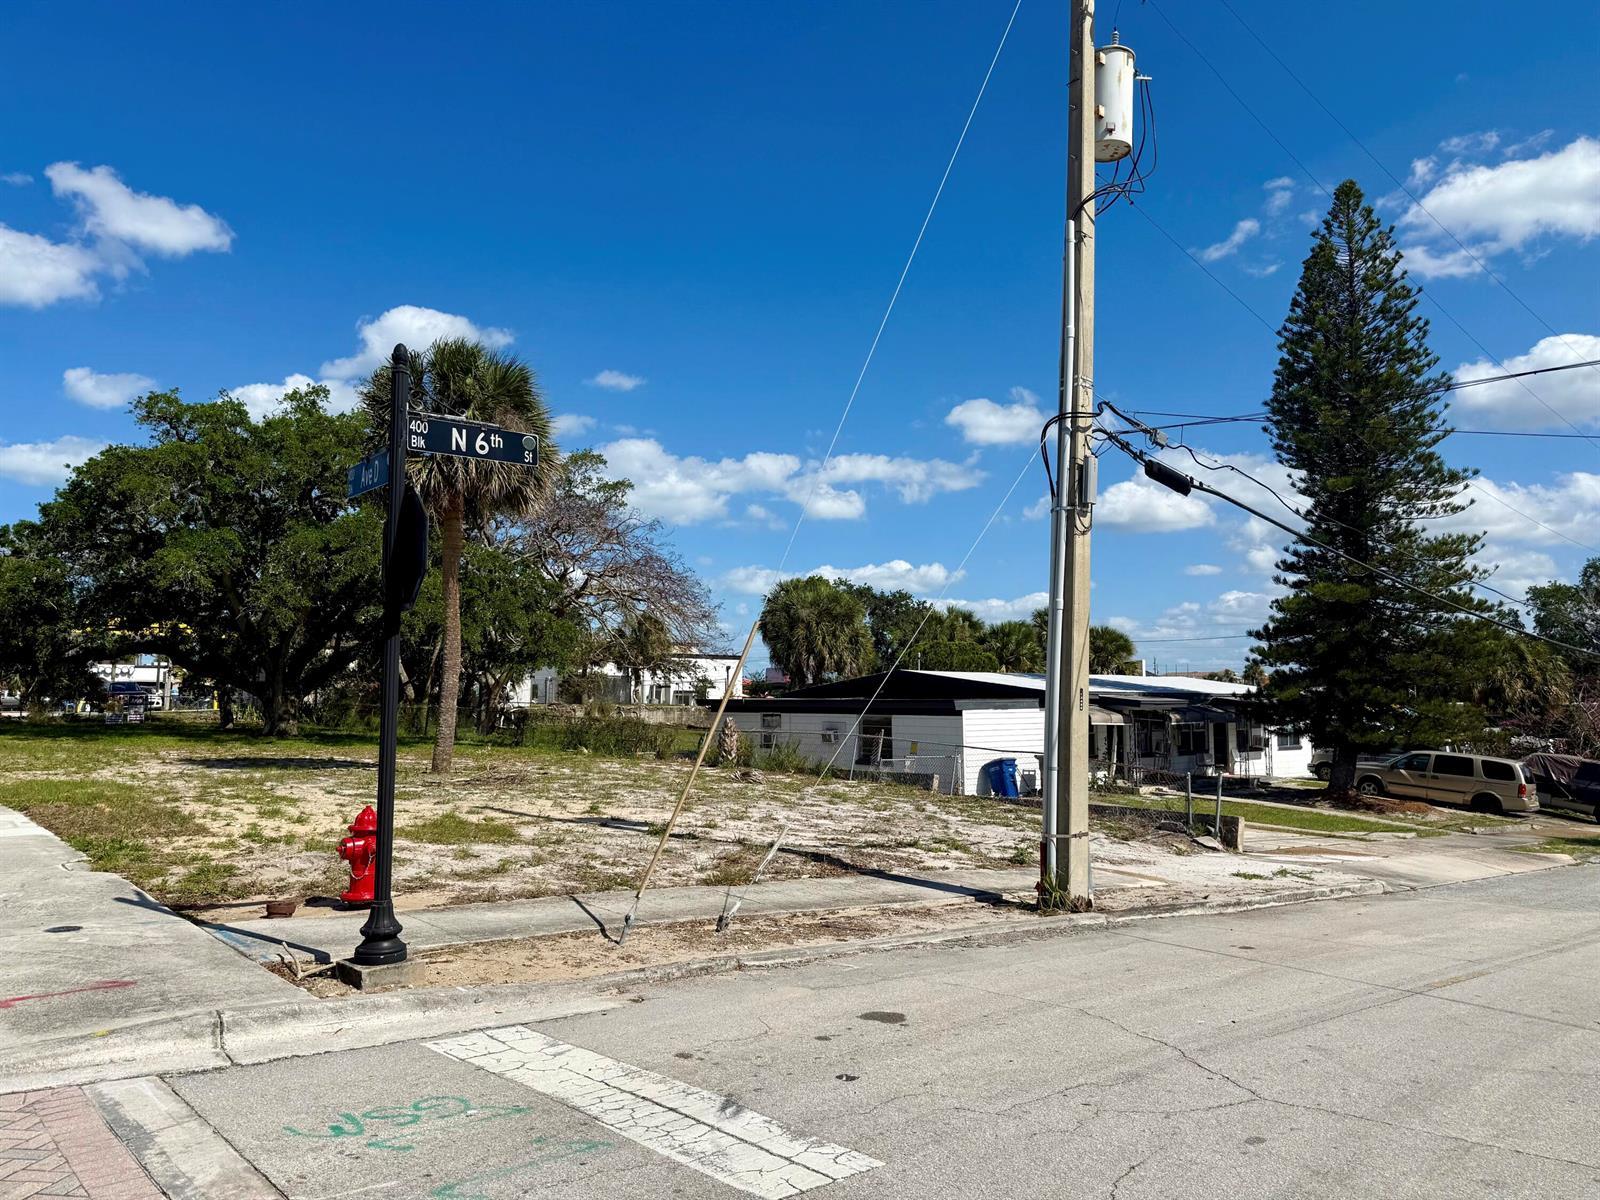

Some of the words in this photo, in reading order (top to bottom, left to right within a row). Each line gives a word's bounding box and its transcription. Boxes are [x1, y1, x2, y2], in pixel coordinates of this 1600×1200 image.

[409, 420, 429, 434] 400
[411, 435, 426, 449] Blk
[451, 427, 467, 452] N
[475, 432, 503, 455] 6th
[524, 450, 533, 463] St
[360, 465, 373, 489] Ave
[373, 460, 379, 483] D
